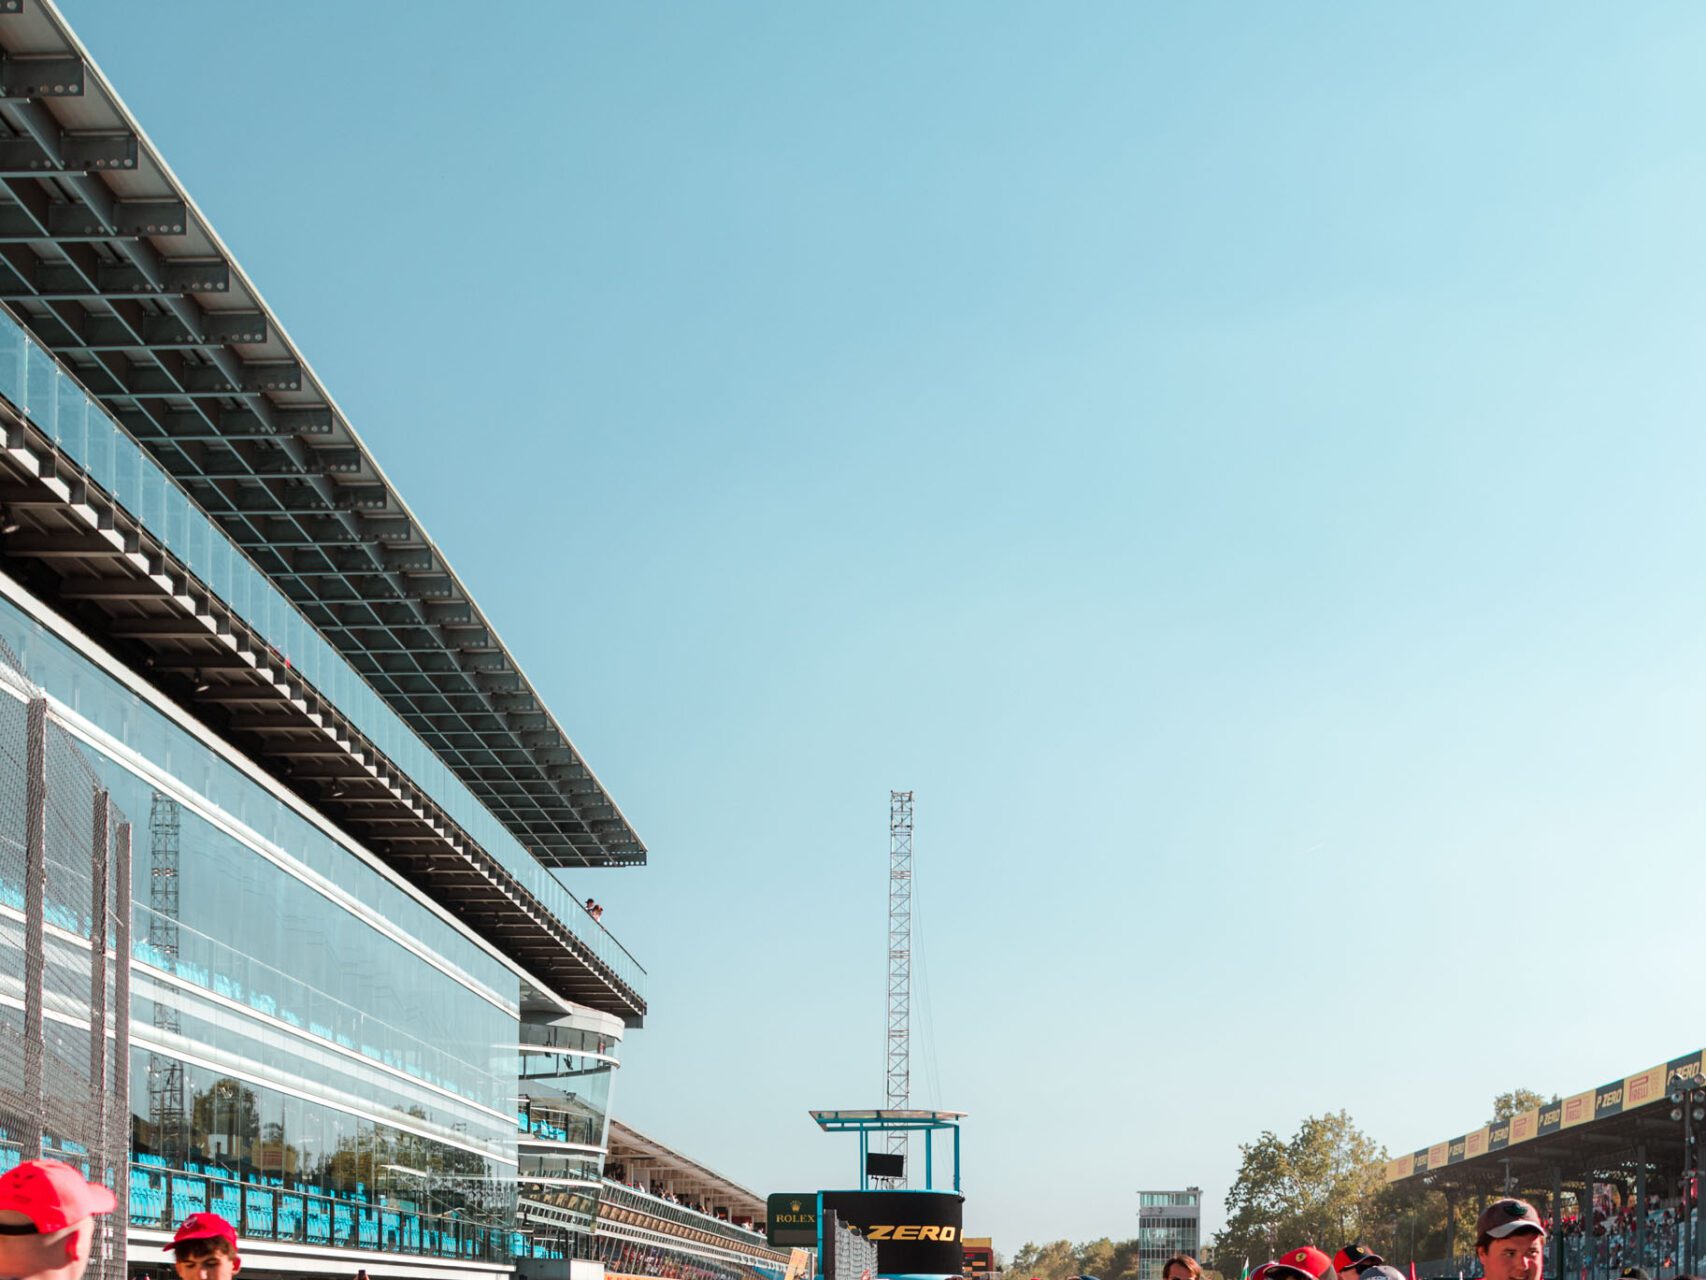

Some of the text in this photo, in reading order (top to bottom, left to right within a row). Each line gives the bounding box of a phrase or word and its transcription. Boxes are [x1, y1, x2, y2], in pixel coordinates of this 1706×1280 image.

[1602, 1088, 1622, 1108] ZERO
[776, 1214, 815, 1223] ROLEX
[867, 1225, 956, 1241] ZERO
